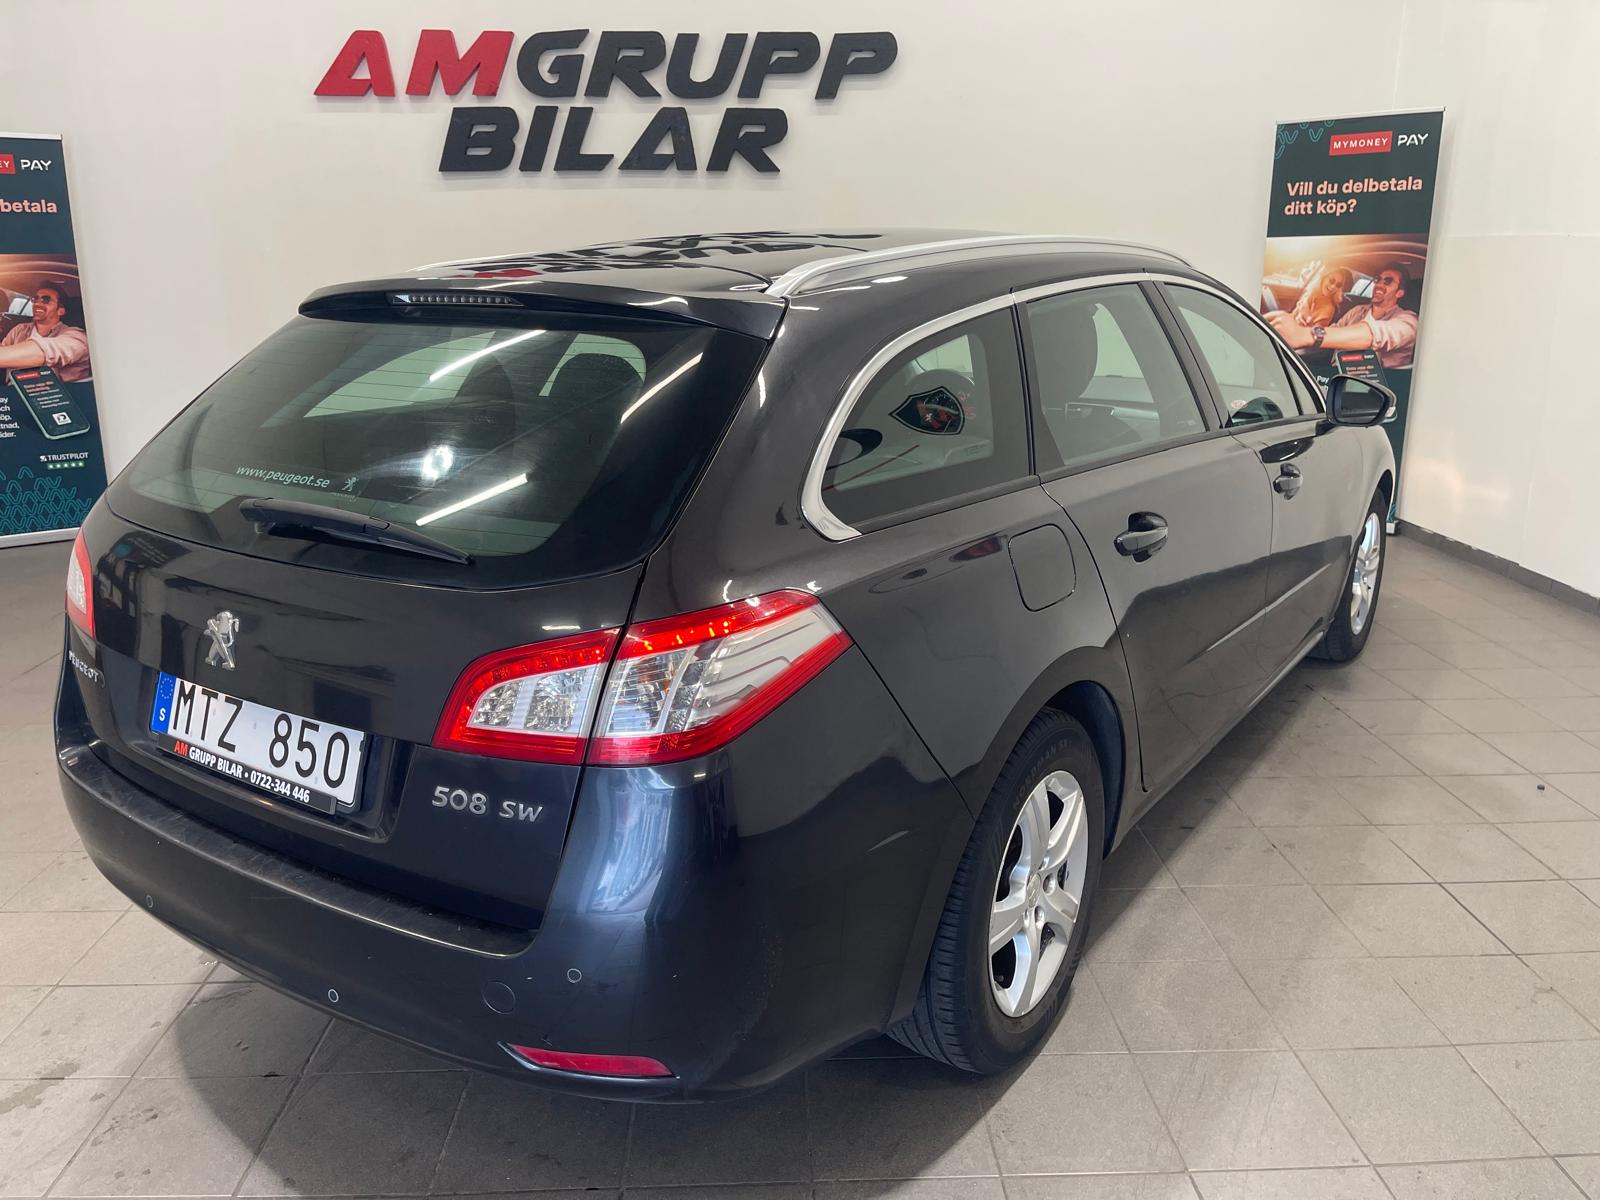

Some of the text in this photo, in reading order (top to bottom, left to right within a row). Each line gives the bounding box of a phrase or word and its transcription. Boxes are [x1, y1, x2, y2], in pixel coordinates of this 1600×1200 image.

[438, 105, 789, 172] BILAR
[1333, 133, 1429, 149] MYMONEY PAY
[20, 159, 52, 170] PAY
[1287, 176, 1423, 197] Vill du delbetala
[1284, 198, 1357, 216] ditt köp?
[48, 452, 89, 461] TRUSTPILOT
[236, 466, 330, 488] www.peugeot.se
[68, 650, 99, 682] PEUGEOT
[159, 707, 166, 721] S
[172, 681, 350, 789] MTZ 850
[173, 740, 310, 803] AM GRUPP BILAR 0722-344 446
[431, 785, 543, 822] 508 SW
